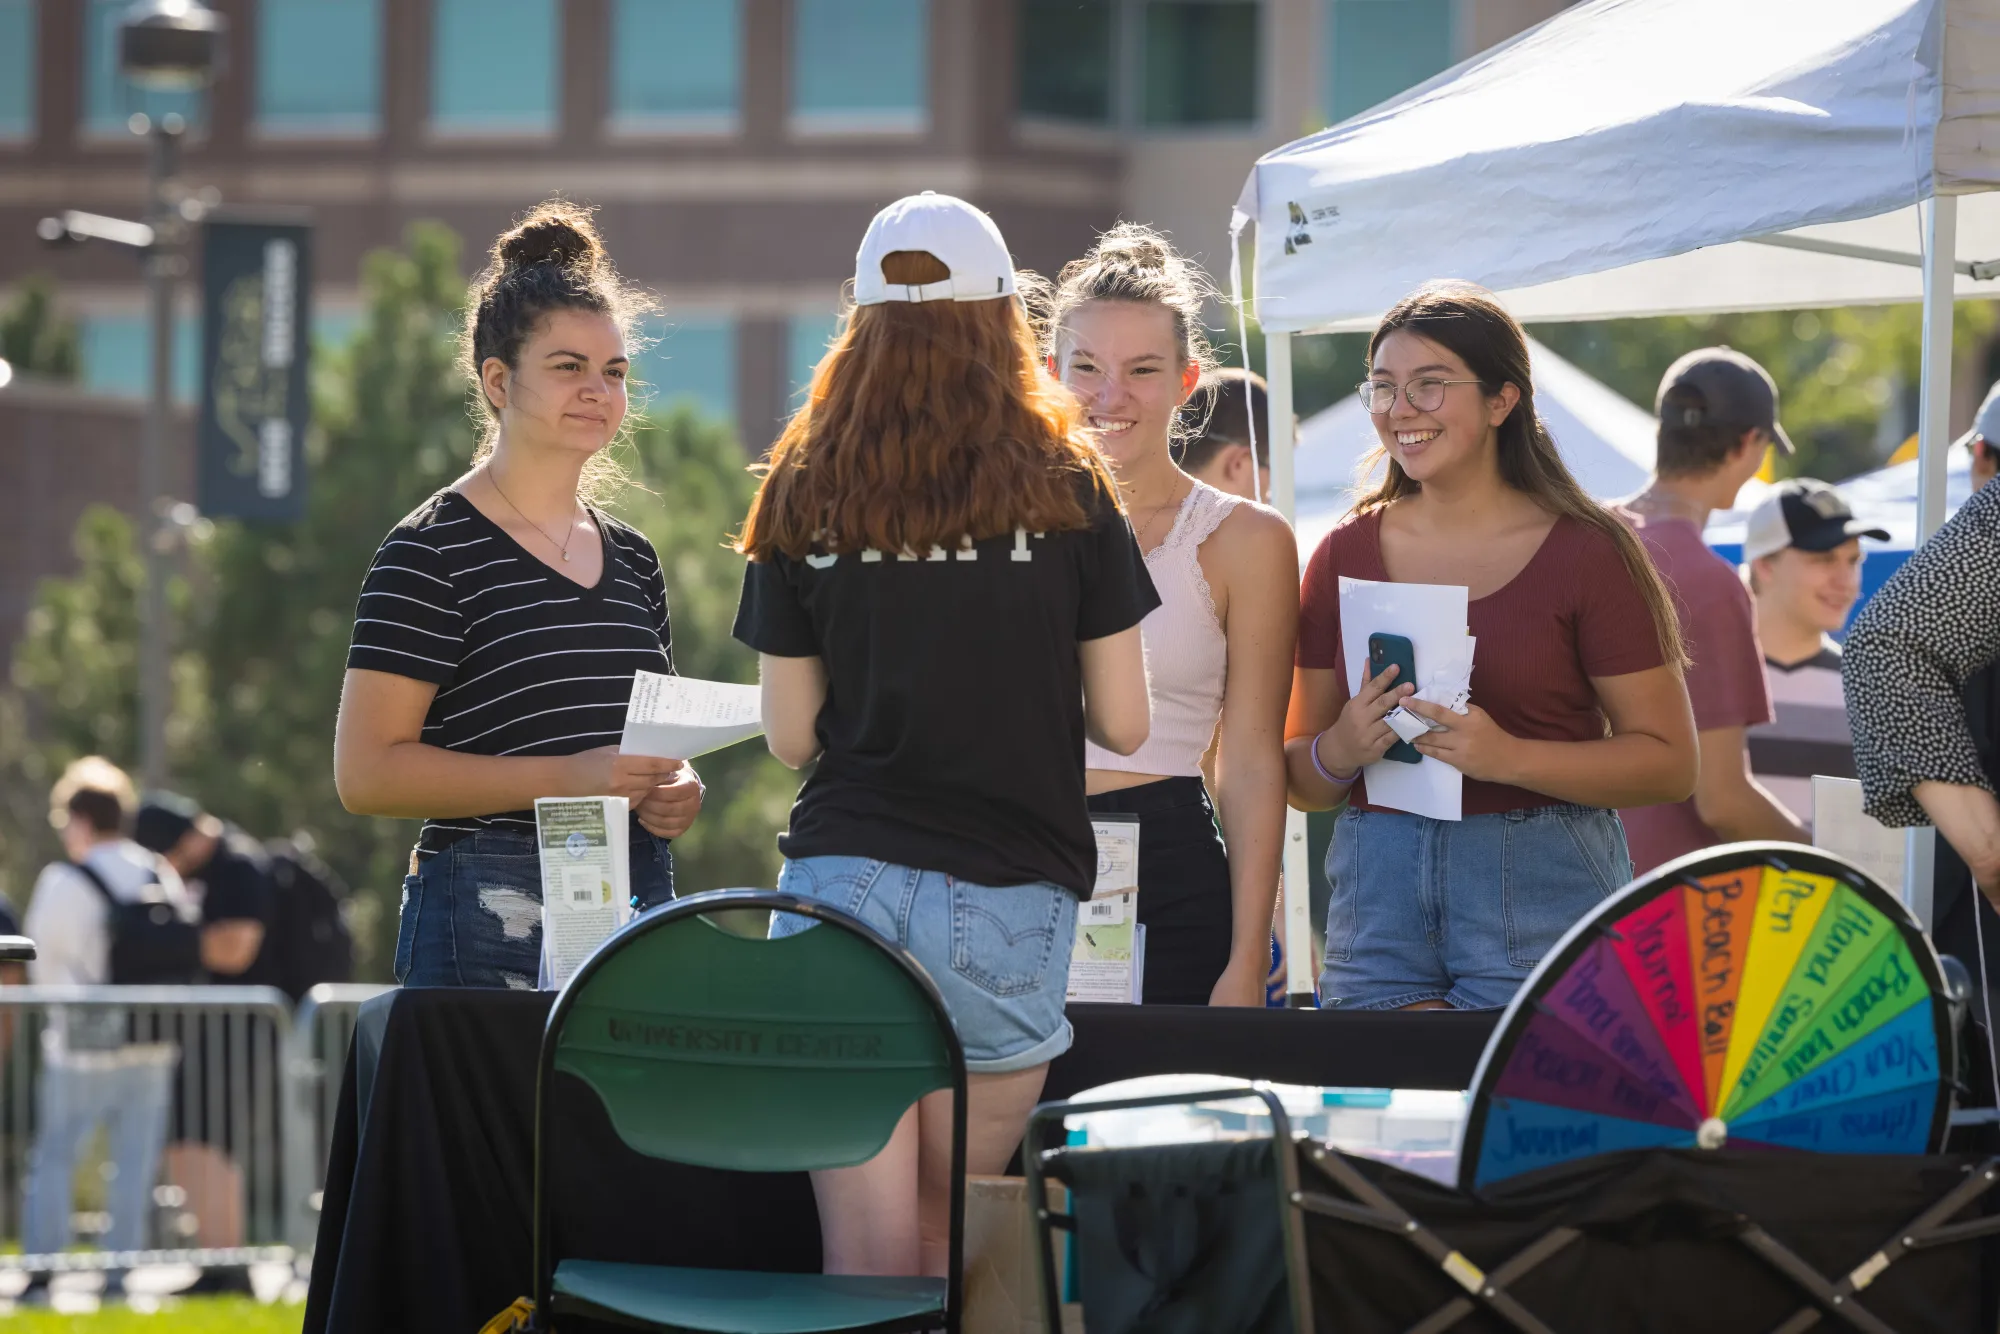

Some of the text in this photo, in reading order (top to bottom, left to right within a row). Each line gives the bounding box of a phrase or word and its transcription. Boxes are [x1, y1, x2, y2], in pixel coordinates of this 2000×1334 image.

[1701, 878, 1743, 994] Beach
[1770, 877, 1817, 933] Pen
[1804, 904, 1874, 986] Hand
[608, 1016, 884, 1059] UNIVERSITY CENTER
